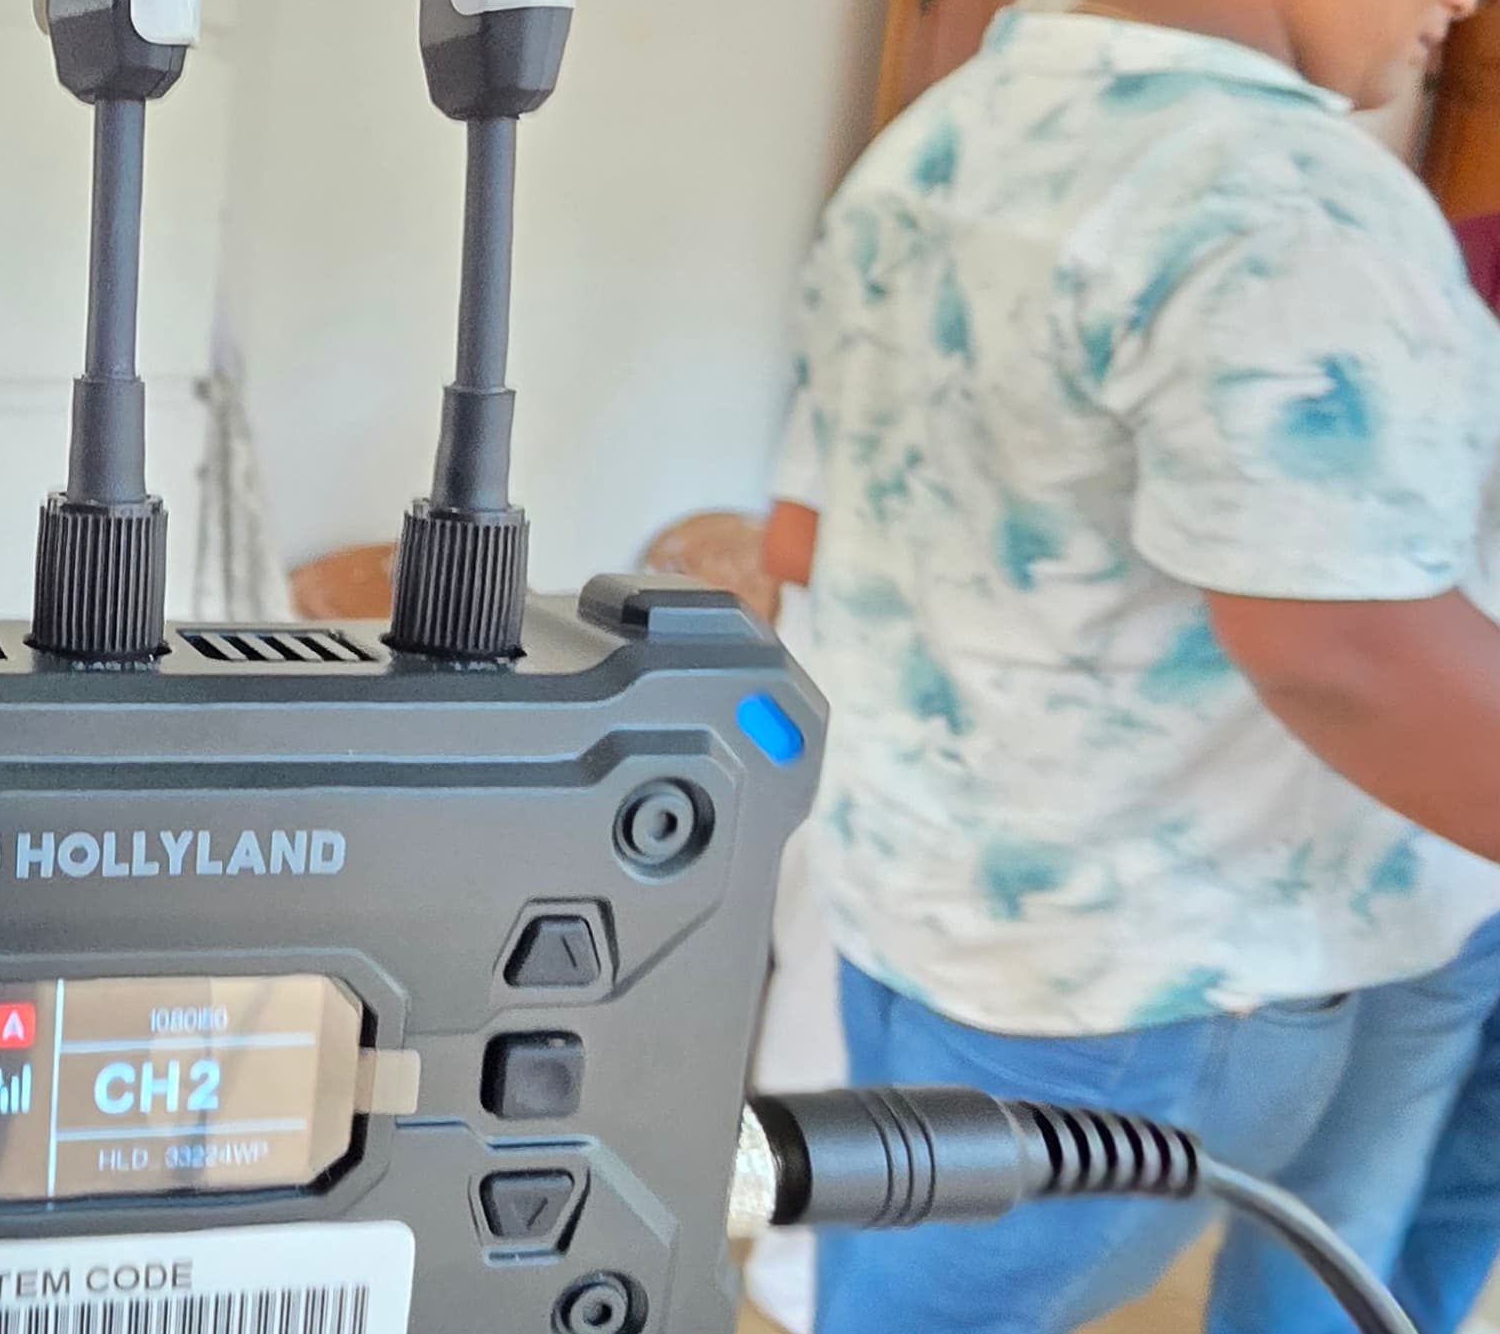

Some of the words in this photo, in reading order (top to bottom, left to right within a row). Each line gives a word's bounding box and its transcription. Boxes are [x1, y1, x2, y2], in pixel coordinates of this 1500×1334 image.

[16, 830, 347, 879] HOLLYLAND
[93, 1058, 221, 1115] CH2
[86, 1258, 193, 1293] CODE
